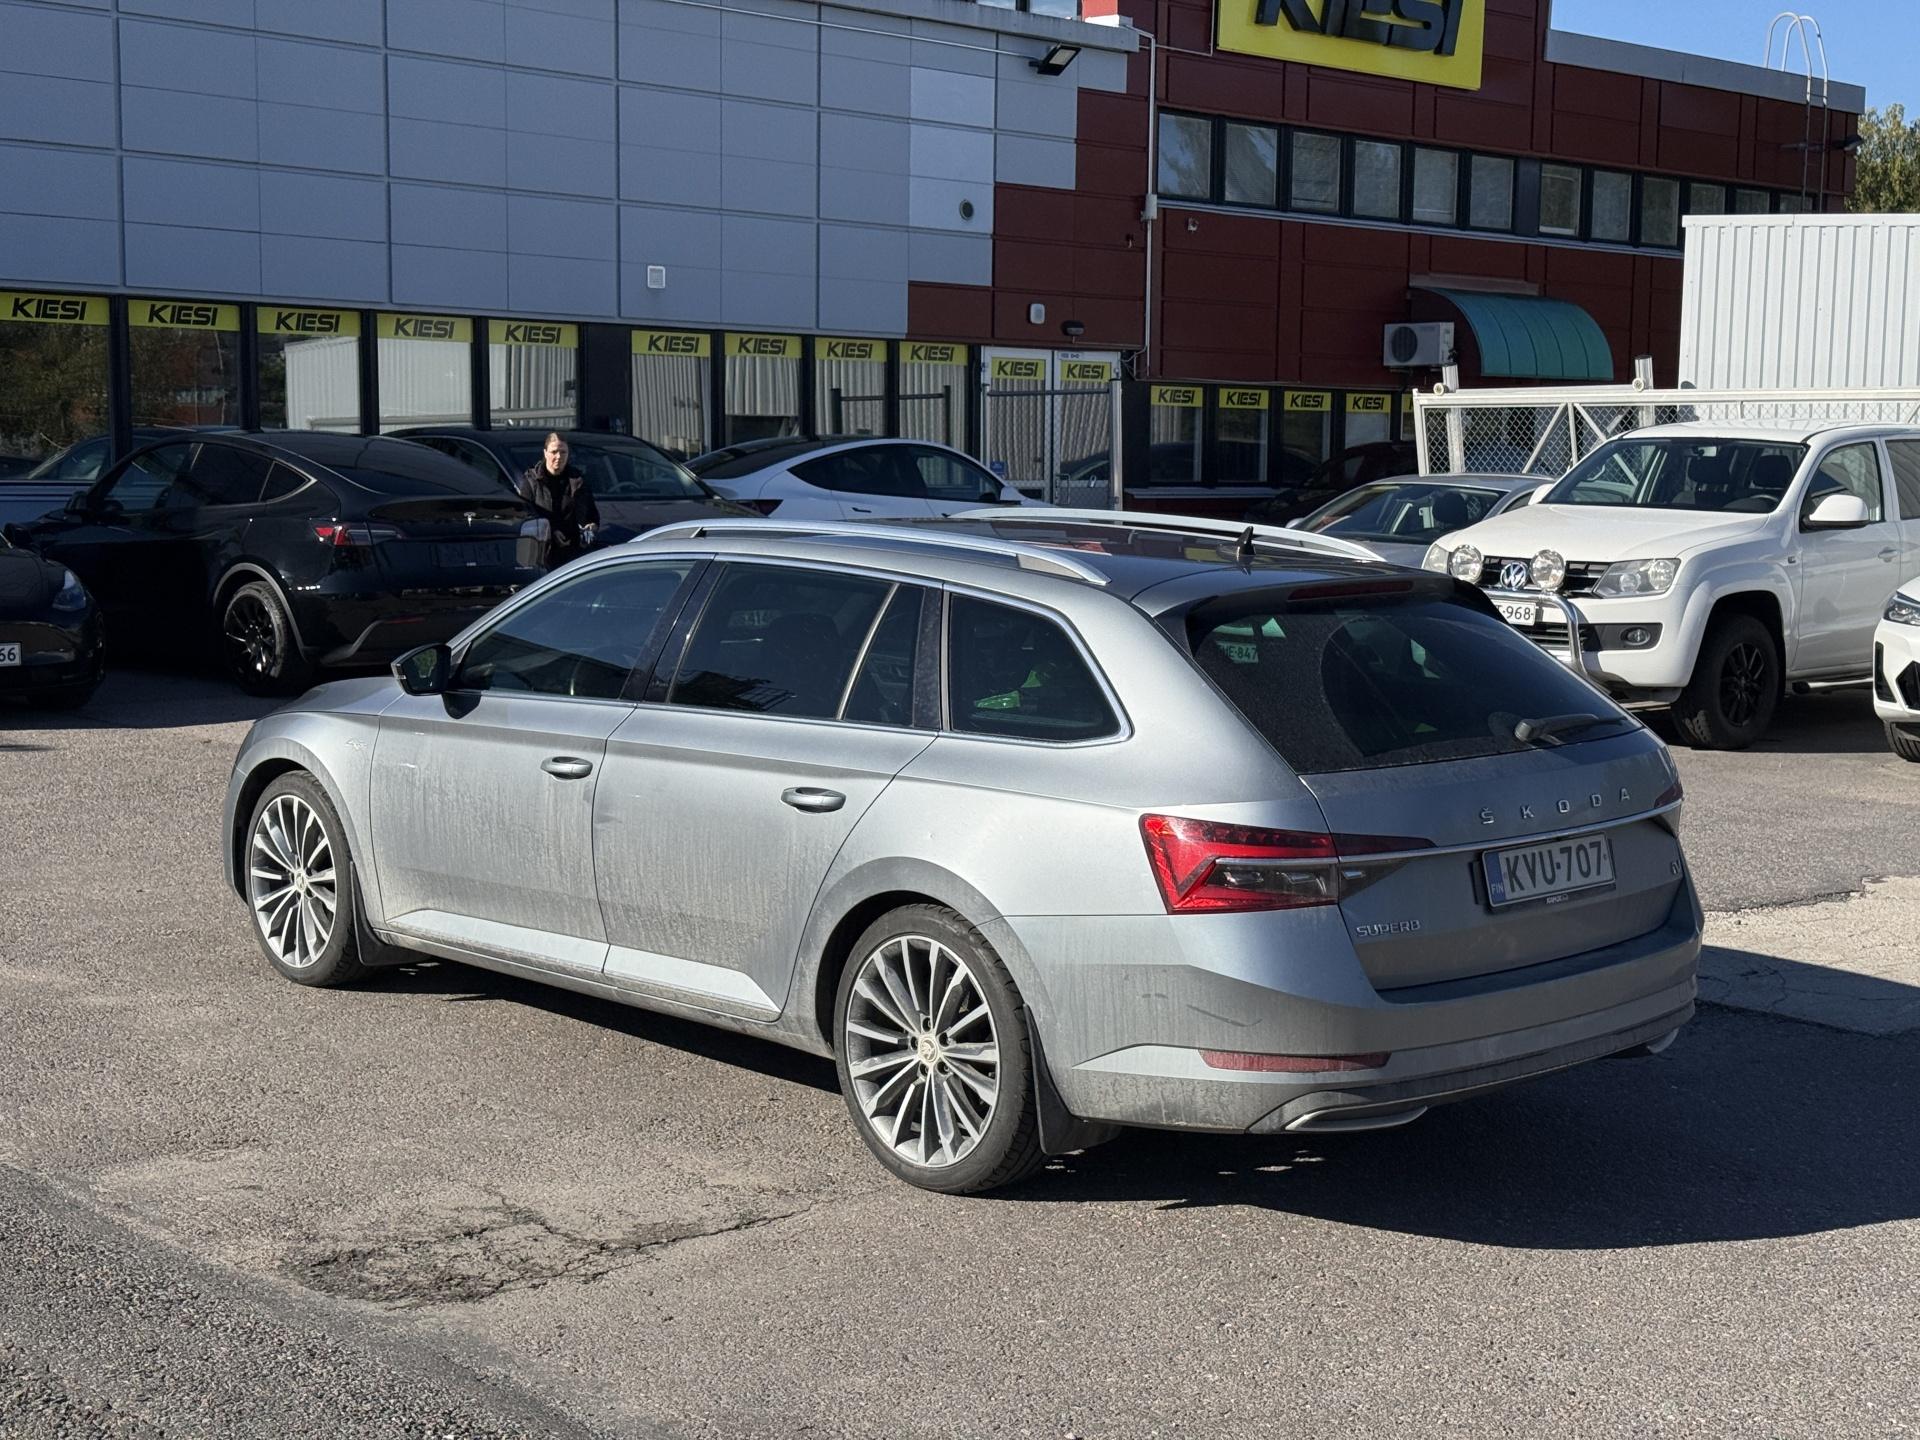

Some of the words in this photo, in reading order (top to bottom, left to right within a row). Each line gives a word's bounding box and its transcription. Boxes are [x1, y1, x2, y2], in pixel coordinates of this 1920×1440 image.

[11, 297, 88, 321] KIESI
[148, 303, 218, 326] KIESI
[275, 311, 340, 333] KIESI
[393, 317, 455, 339] KIESI
[504, 324, 561, 345] KIESI
[648, 334, 699, 353] KIESI
[737, 337, 787, 356] KIESI
[826, 341, 873, 359] KIESI
[910, 344, 955, 362] KIESI
[997, 361, 1038, 377] KIESI
[1066, 363, 1105, 379] KIESI
[1158, 388, 1194, 404] KIESI
[1226, 391, 1261, 407] KIESI
[1290, 393, 1324, 408] KIESI
[1352, 396, 1384, 410] KIESI
[1505, 841, 1602, 893] KVU-707
[1356, 919, 1421, 937] SUPERB
